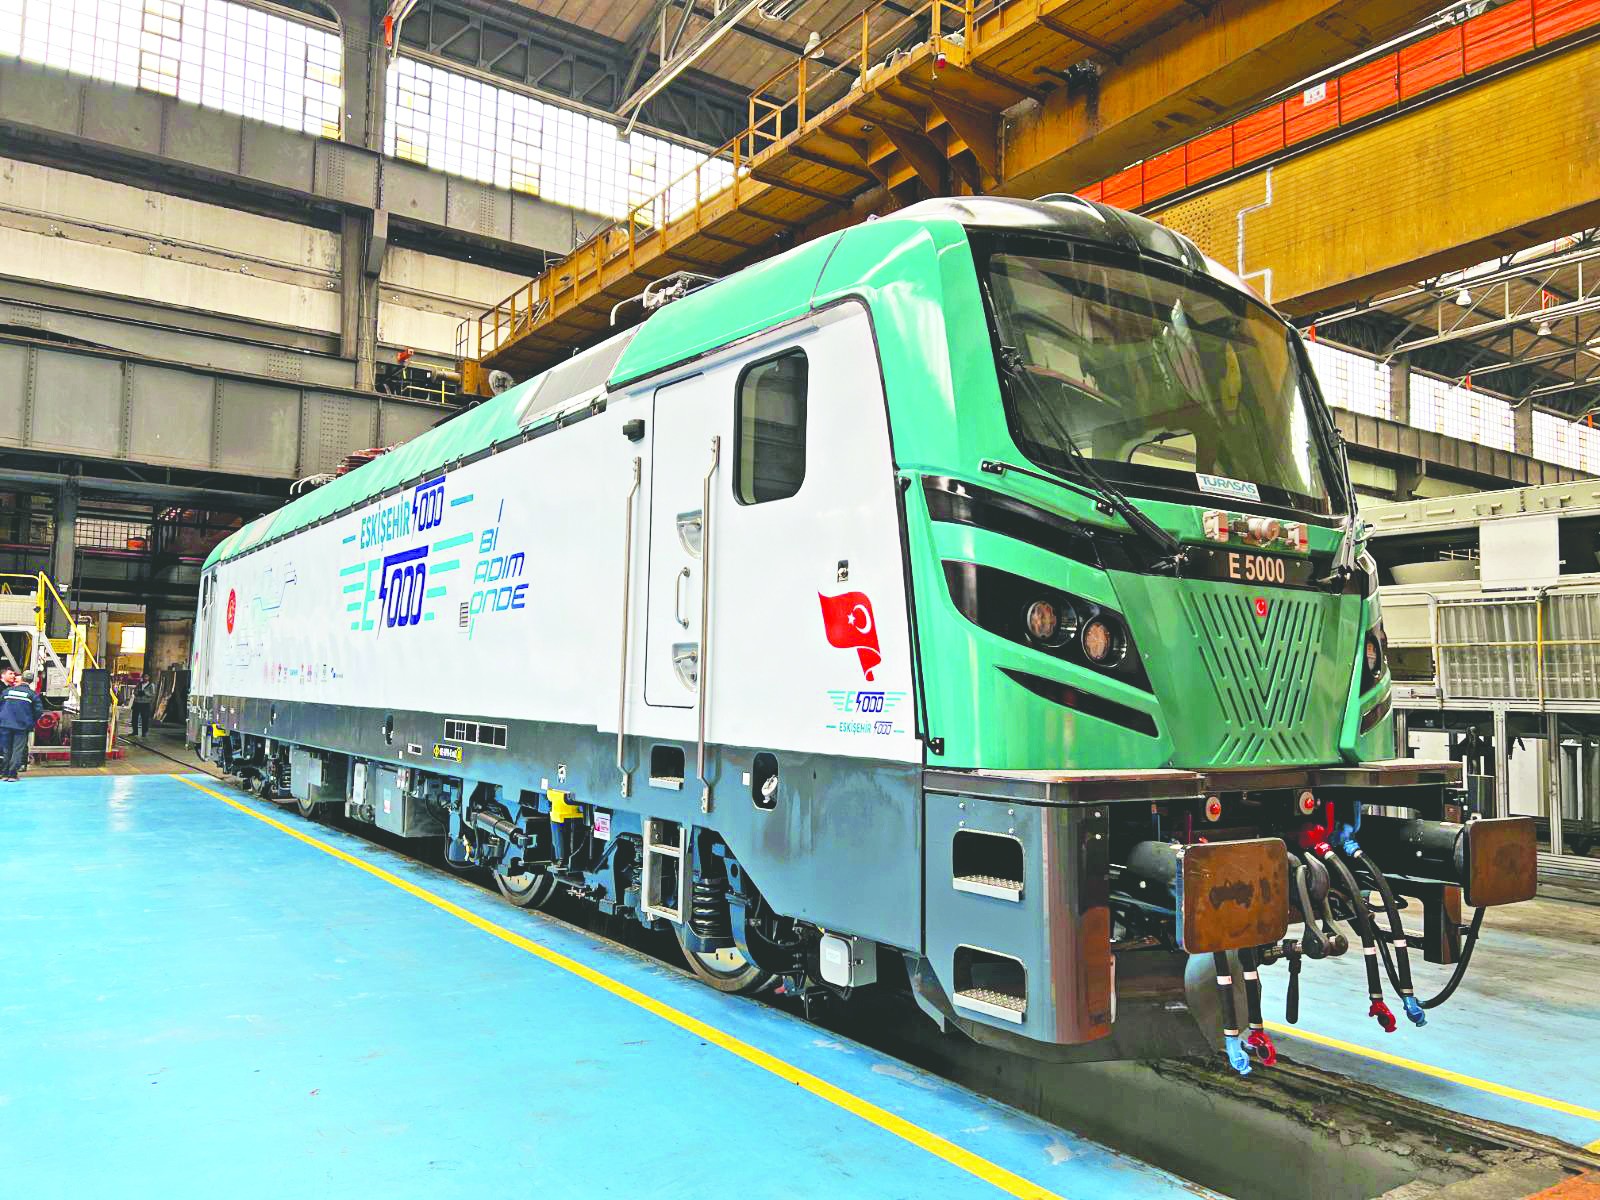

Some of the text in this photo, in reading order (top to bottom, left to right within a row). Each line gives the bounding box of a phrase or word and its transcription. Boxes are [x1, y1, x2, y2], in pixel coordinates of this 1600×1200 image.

[360, 494, 410, 552] ESKİŞEHİR
[474, 552, 525, 584] ADIM
[1228, 552, 1285, 584] E 5000
[839, 720, 871, 736] ESKİŞEHİR
